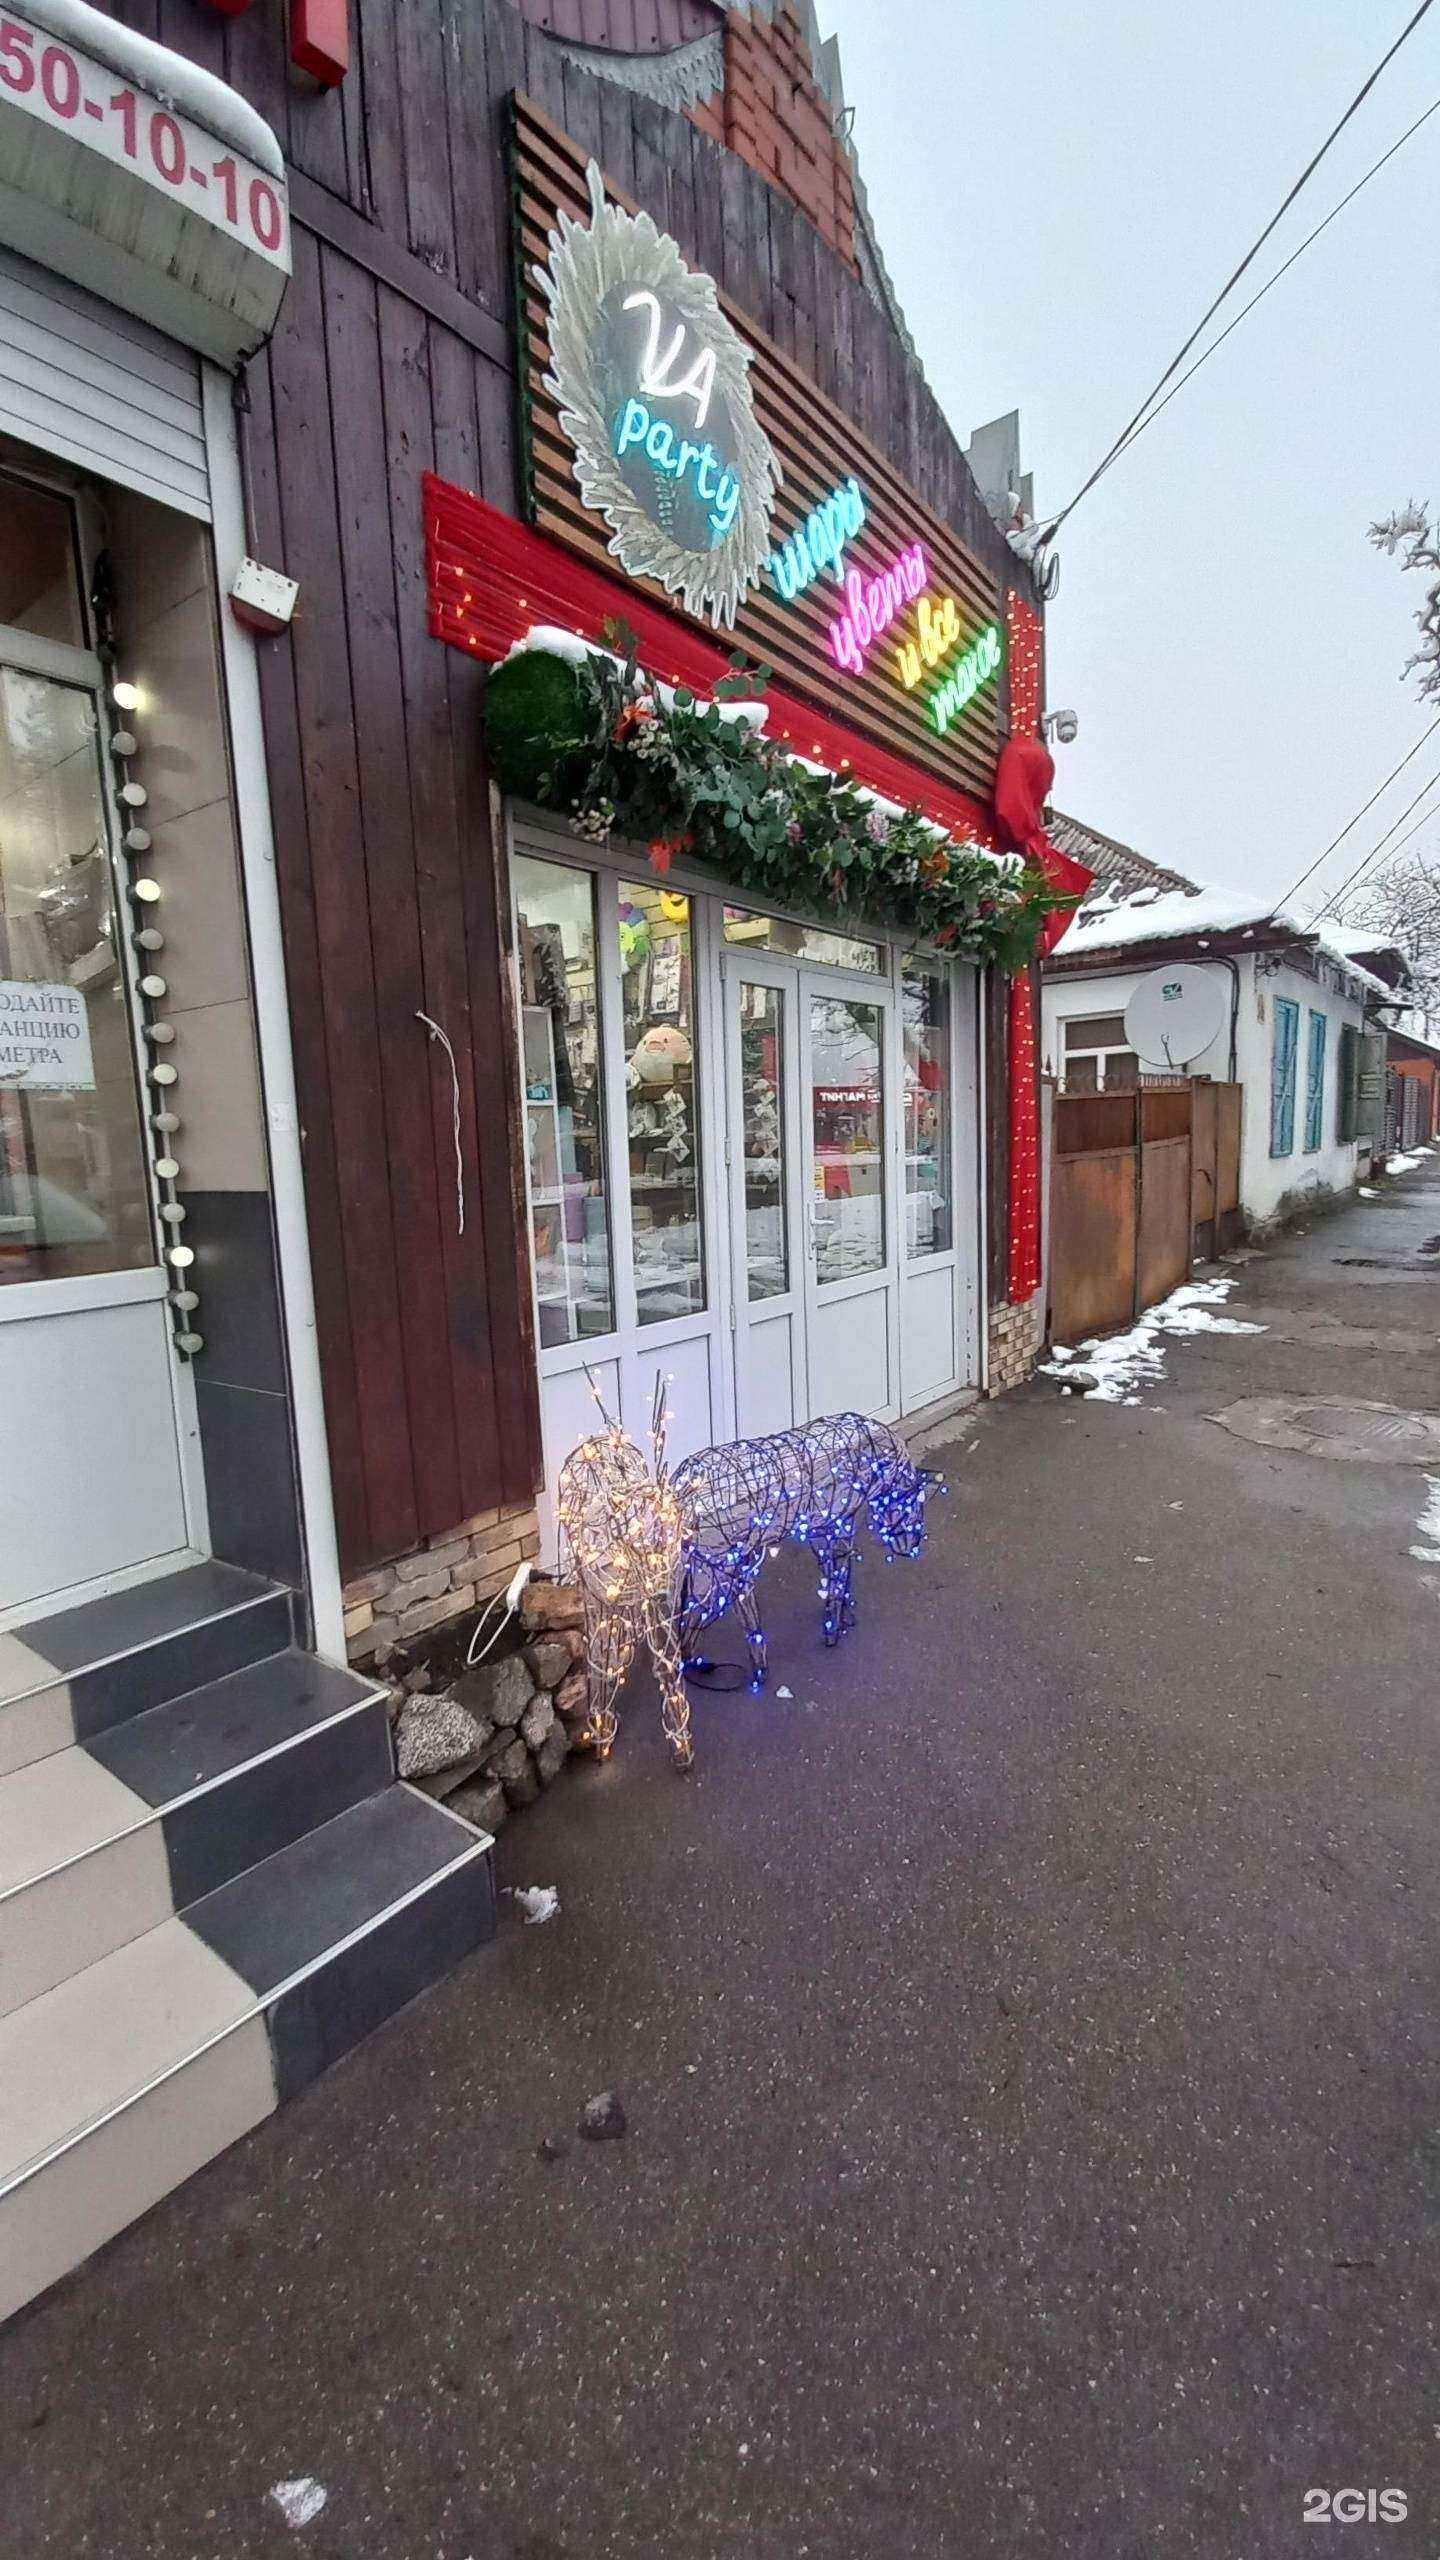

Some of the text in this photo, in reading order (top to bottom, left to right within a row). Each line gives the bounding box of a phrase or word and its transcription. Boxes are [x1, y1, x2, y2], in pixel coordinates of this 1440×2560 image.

[623, 291, 716, 429] VA
[617, 398, 739, 531] party
[763, 478, 865, 599] шары
[829, 543, 927, 675] цветы
[897, 642, 922, 688] и
